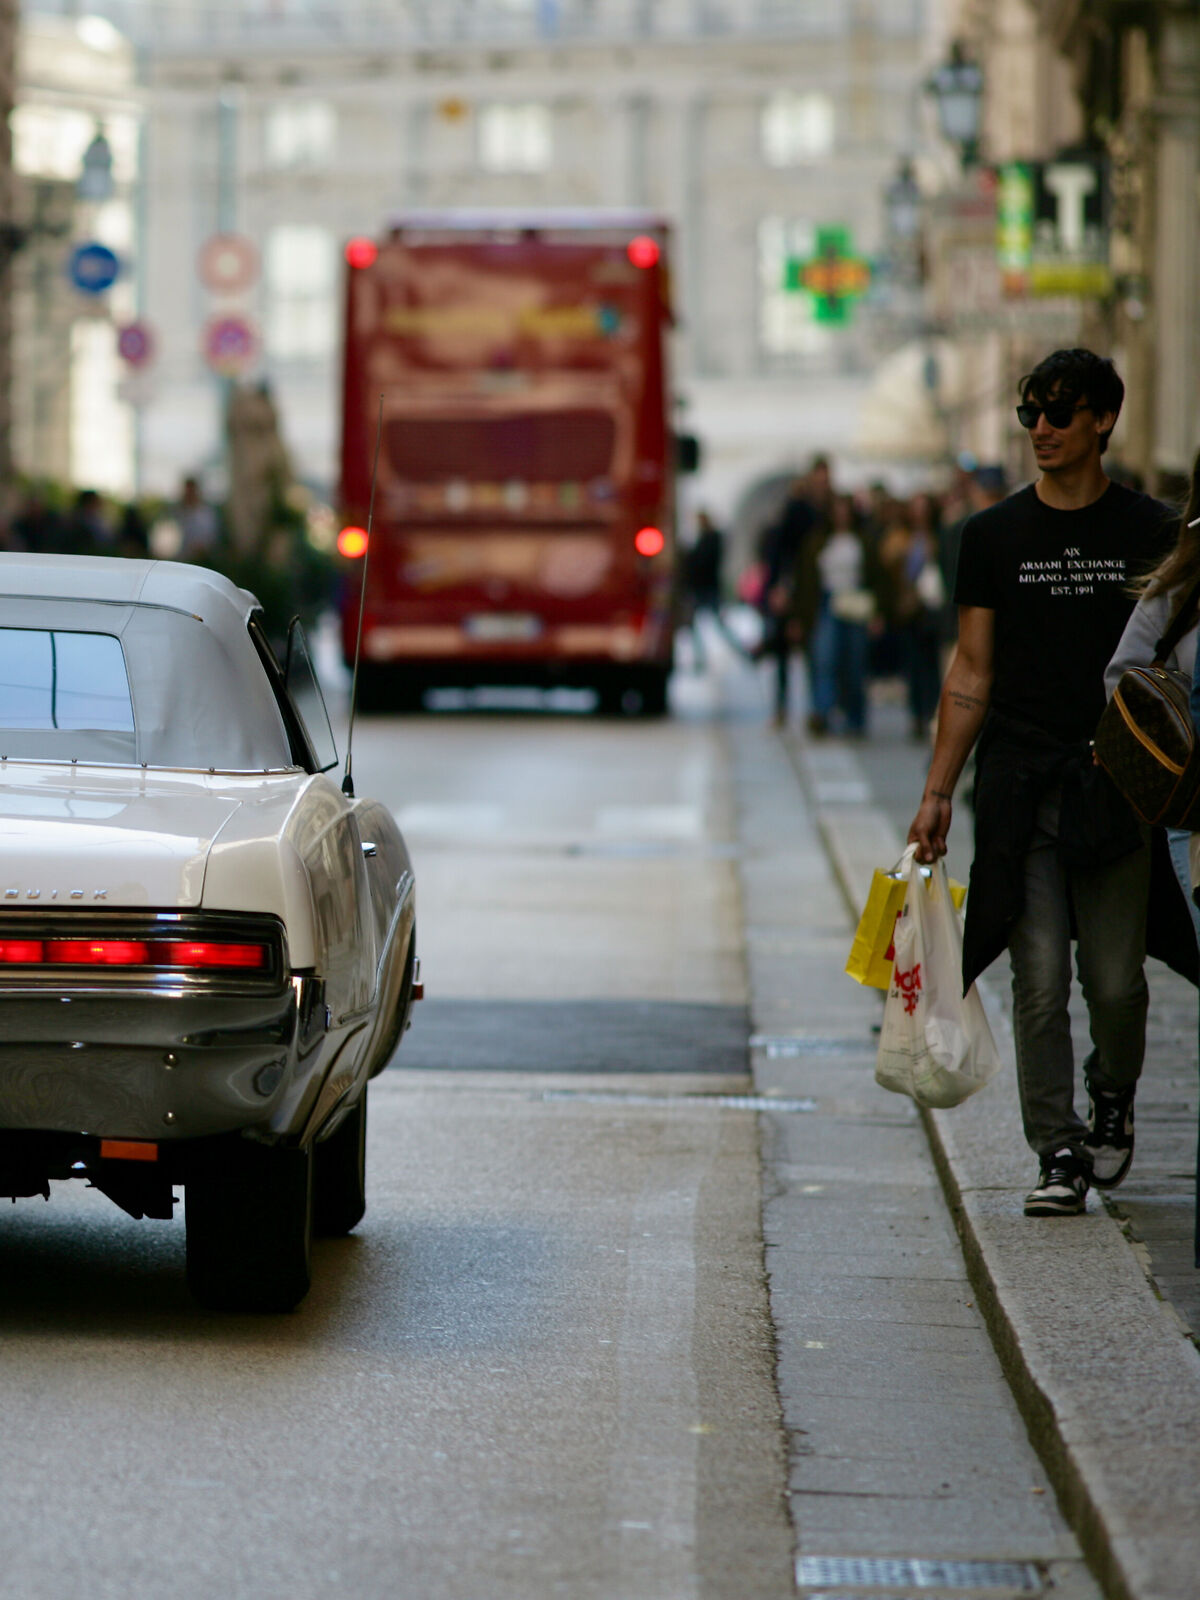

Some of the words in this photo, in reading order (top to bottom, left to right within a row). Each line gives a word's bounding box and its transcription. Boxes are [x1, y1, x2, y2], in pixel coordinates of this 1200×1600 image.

[1044, 163, 1097, 253] T
[1019, 561, 1062, 571] ARMANI
[1067, 559, 1126, 569] EXCHANGE
[1019, 574, 1062, 583] MILANO
[1070, 573, 1095, 582] NEW
[1096, 572, 1126, 582] YORK
[1051, 586, 1072, 596] EST.
[1075, 585, 1094, 595] 1991
[4, 888, 109, 900] BUICK
